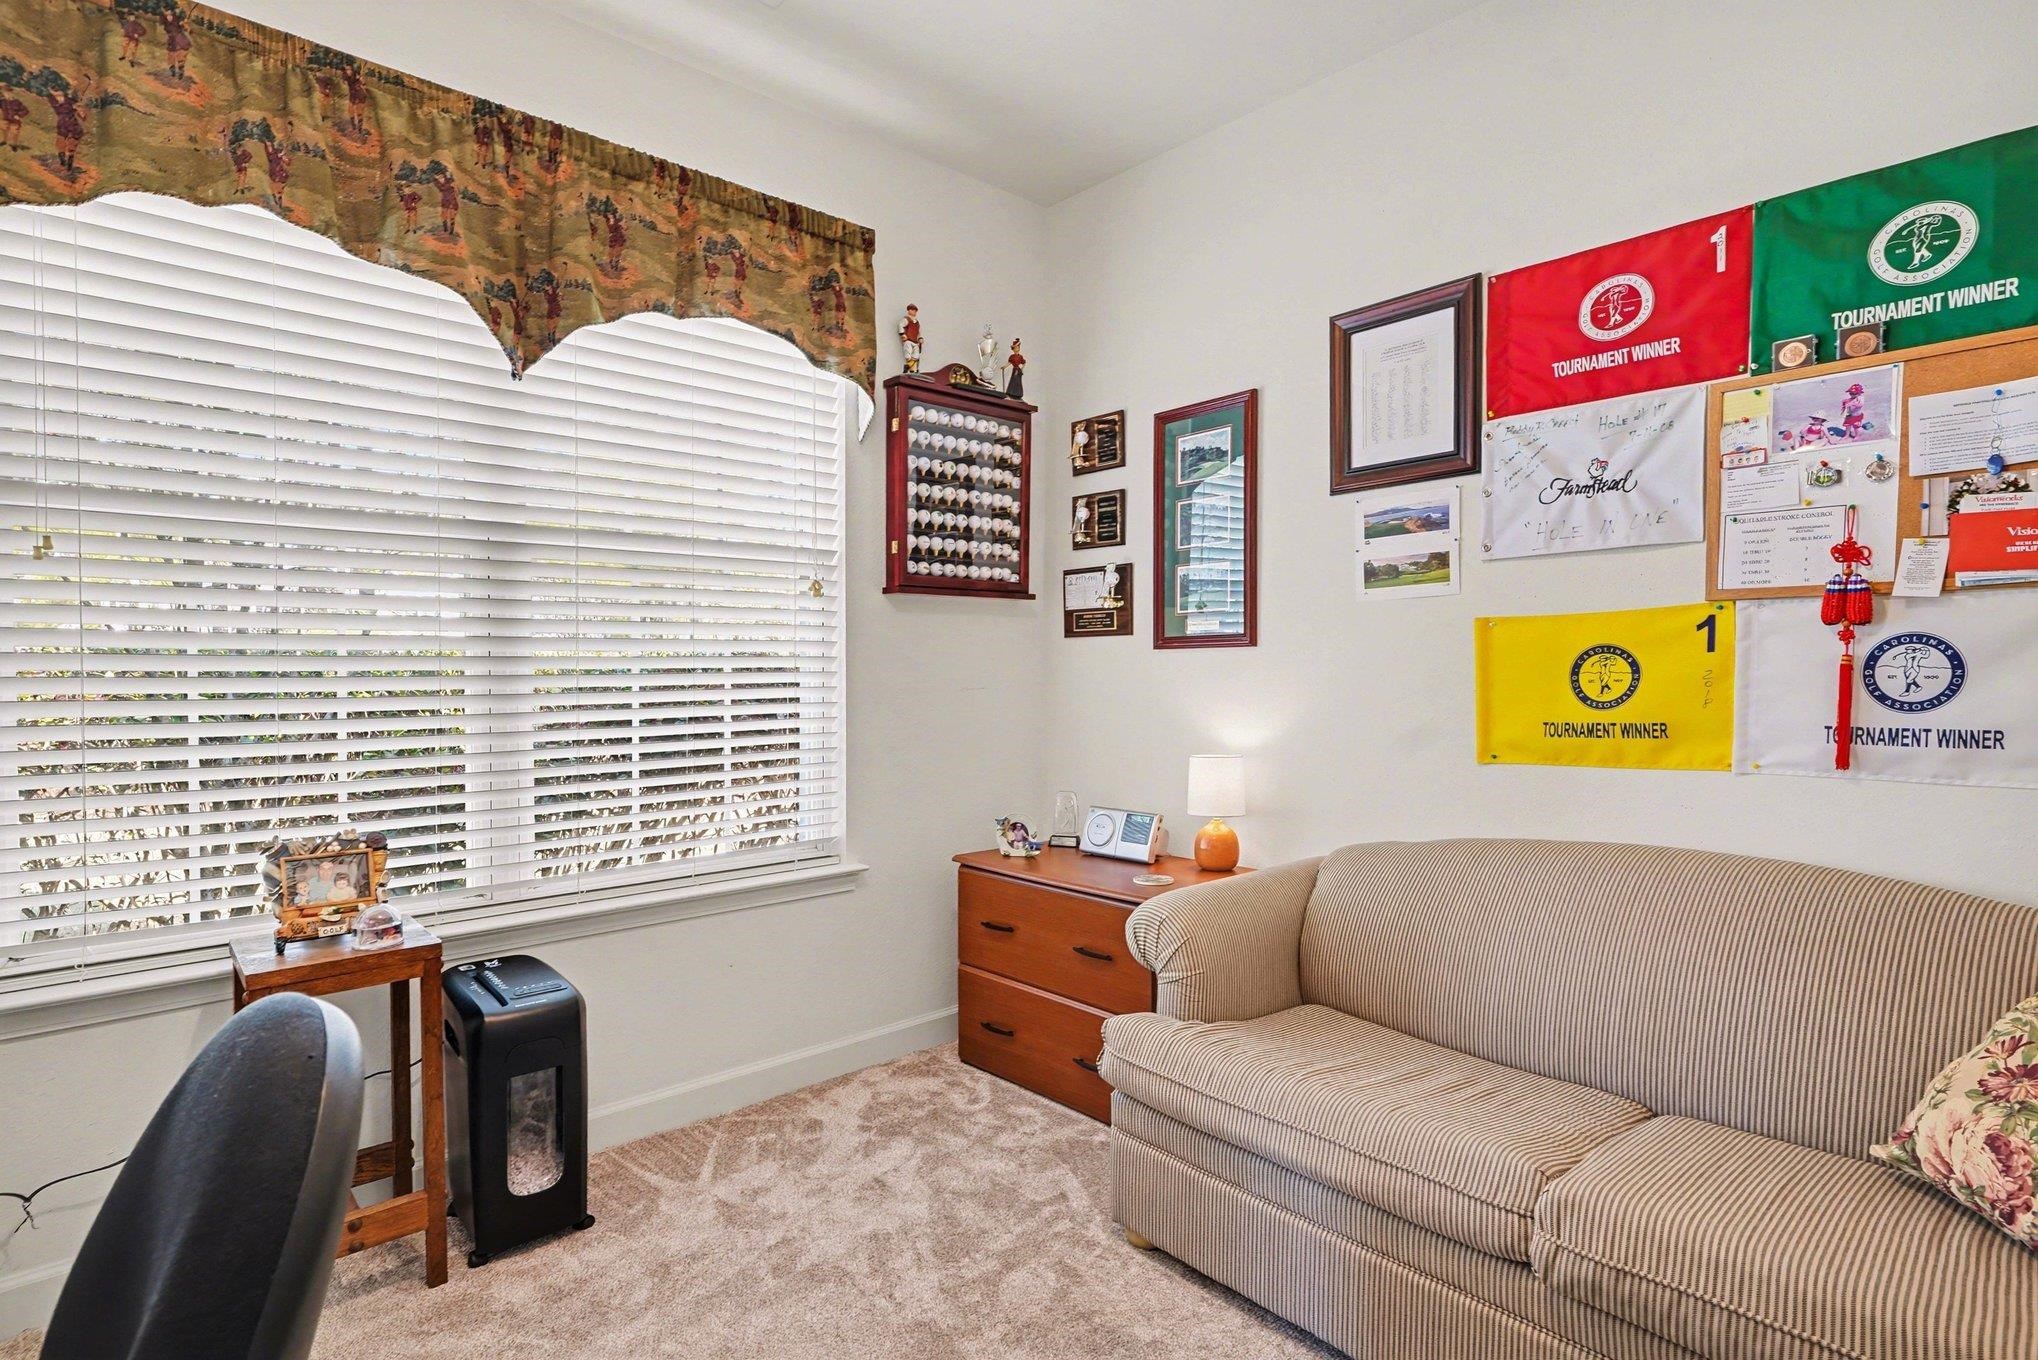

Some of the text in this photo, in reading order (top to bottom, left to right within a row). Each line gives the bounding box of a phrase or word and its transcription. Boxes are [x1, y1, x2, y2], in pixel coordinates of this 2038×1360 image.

[1884, 205, 1965, 235] CAROLINAS
[1710, 225, 1727, 273] 1
[1873, 228, 1973, 282] GOLF ASSOCIATION
[1831, 277, 2020, 330] TOURNAMENT WINNER
[1552, 337, 1681, 378] TOURNAMENT WINNER
[1539, 469, 1638, 504] Farmstead
[1696, 614, 1717, 653] 1
[1874, 636, 1954, 656] CAROLINAS
[1578, 647, 1634, 665] CAROLINAS
[1586, 673, 1639, 708] ASSOCIATION
[1865, 669, 1963, 711] GOLF ASSOCIATION
[1542, 722, 1669, 740] TOURNAMENT WINNER
[1937, 728, 2005, 750] WINNER
